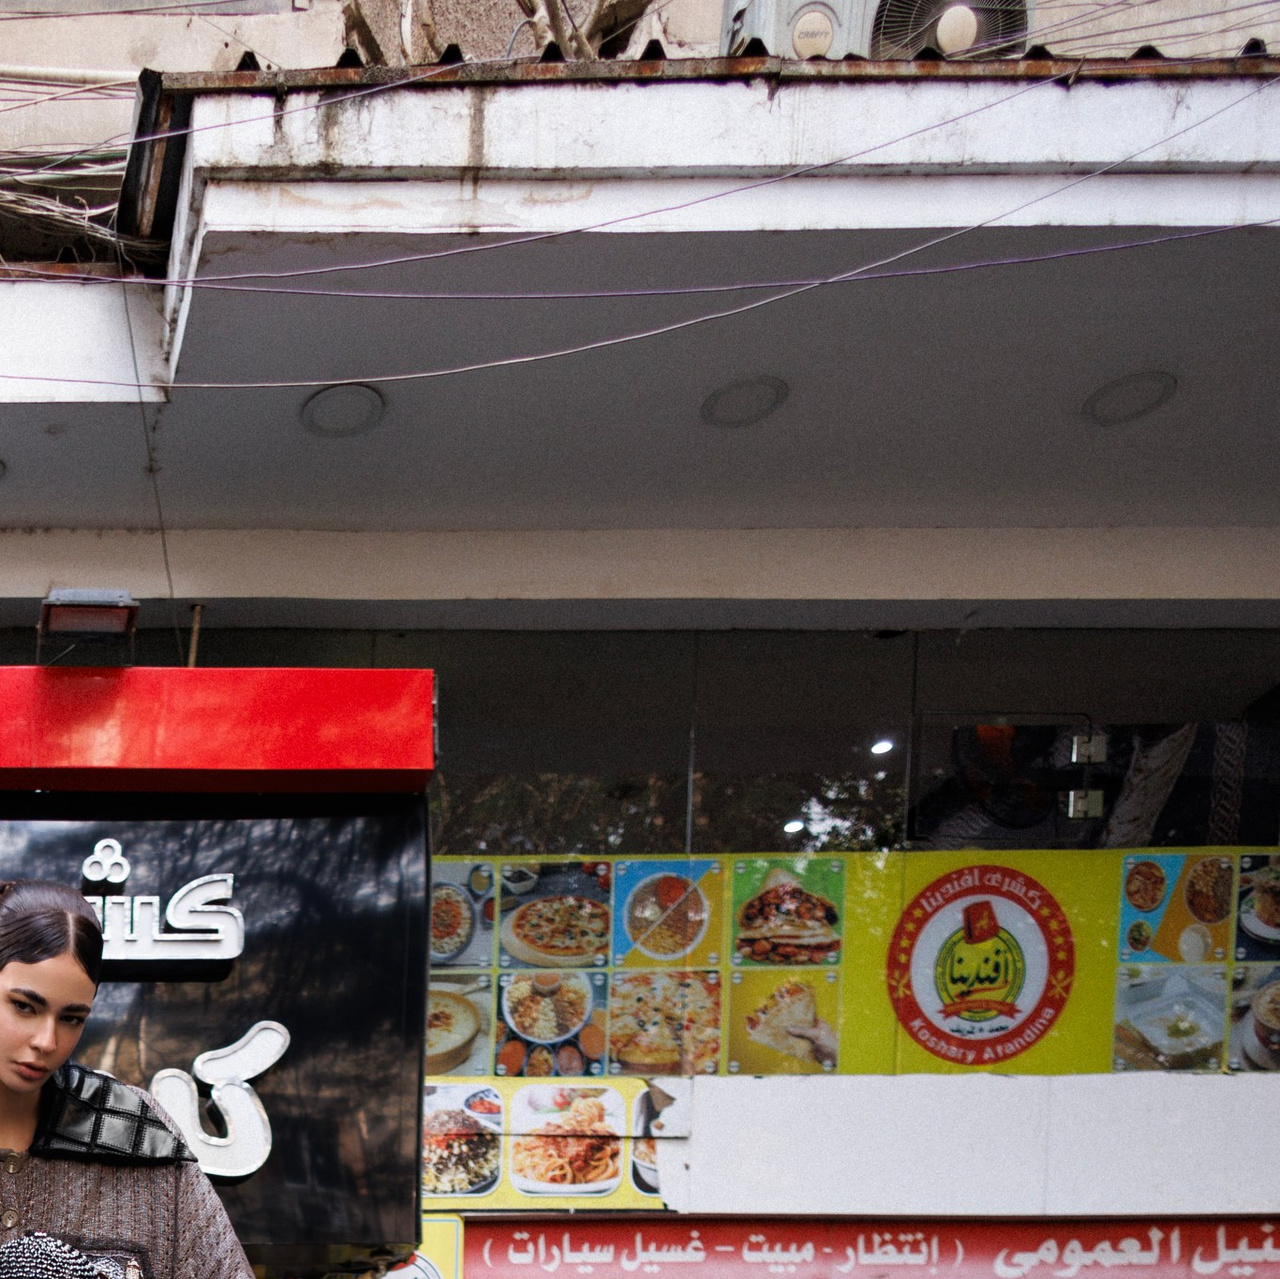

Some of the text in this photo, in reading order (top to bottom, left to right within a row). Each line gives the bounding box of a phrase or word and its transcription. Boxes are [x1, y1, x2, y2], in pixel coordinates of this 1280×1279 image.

[909, 1006, 1055, 1064] Koshary Afandina
[507, 1231, 614, 1273] سيارات
[620, 1230, 706, 1273] غسيل
[741, 1233, 815, 1273] مبيت
